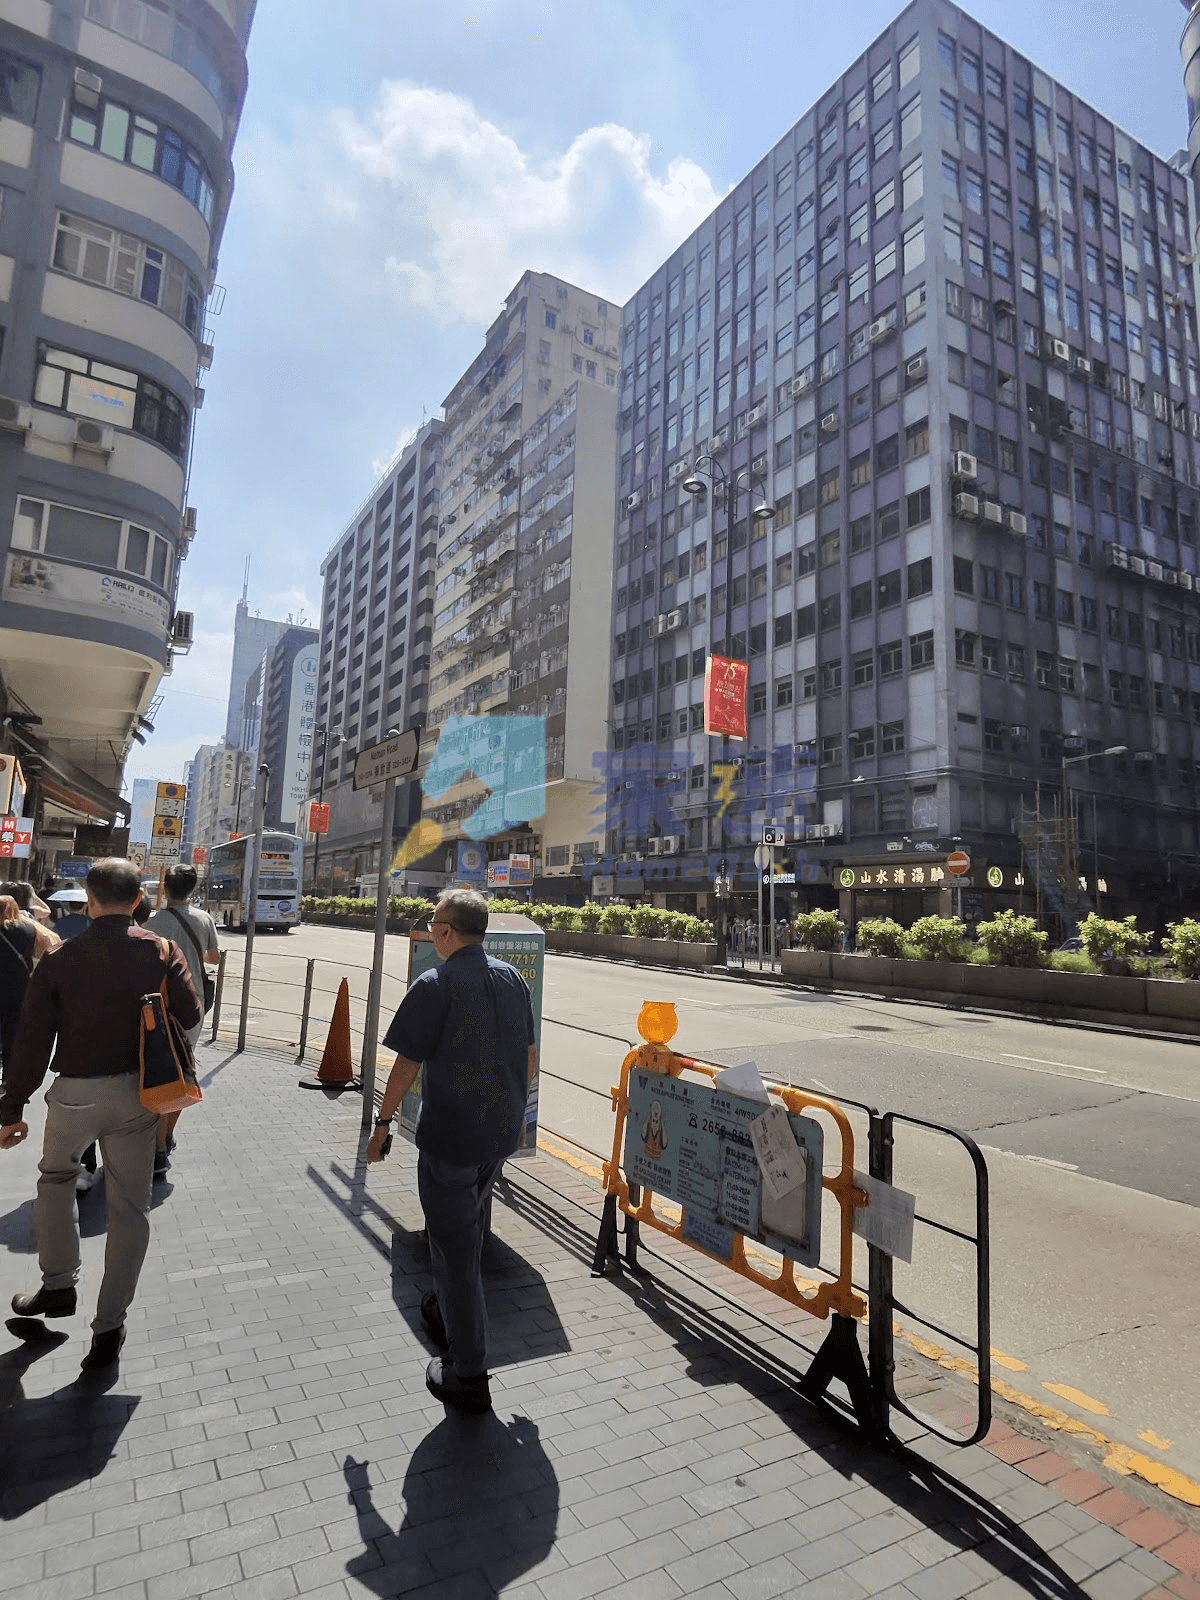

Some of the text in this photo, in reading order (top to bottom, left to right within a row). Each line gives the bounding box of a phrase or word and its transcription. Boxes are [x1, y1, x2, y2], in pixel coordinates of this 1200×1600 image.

[386, 740, 399, 754] Road
[4, 820, 14, 829] M
[18, 833, 28, 842] Y
[508, 953, 537, 964] 7717
